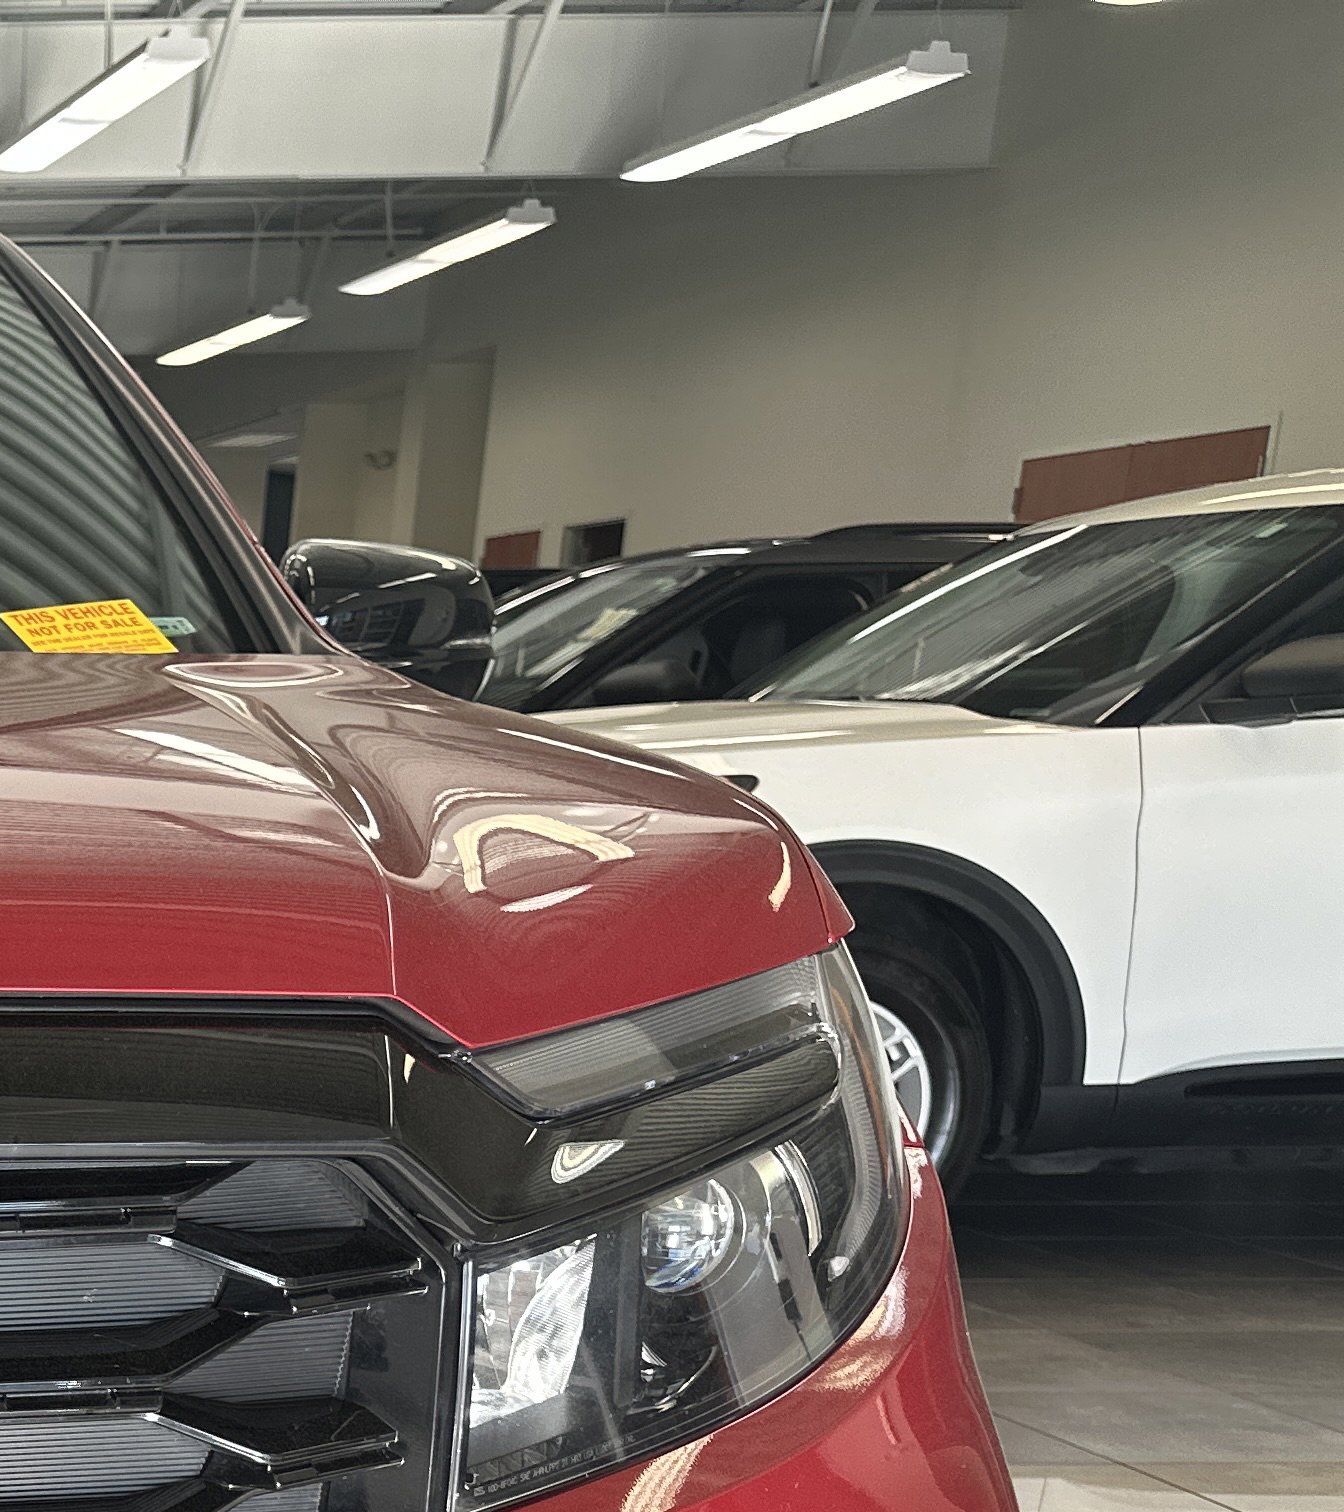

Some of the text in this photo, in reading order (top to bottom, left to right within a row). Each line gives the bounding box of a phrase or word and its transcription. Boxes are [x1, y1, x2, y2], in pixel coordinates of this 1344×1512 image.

[8, 603, 136, 626] THIS VEHICLE
[26, 617, 143, 637] NOT FOR SALE
